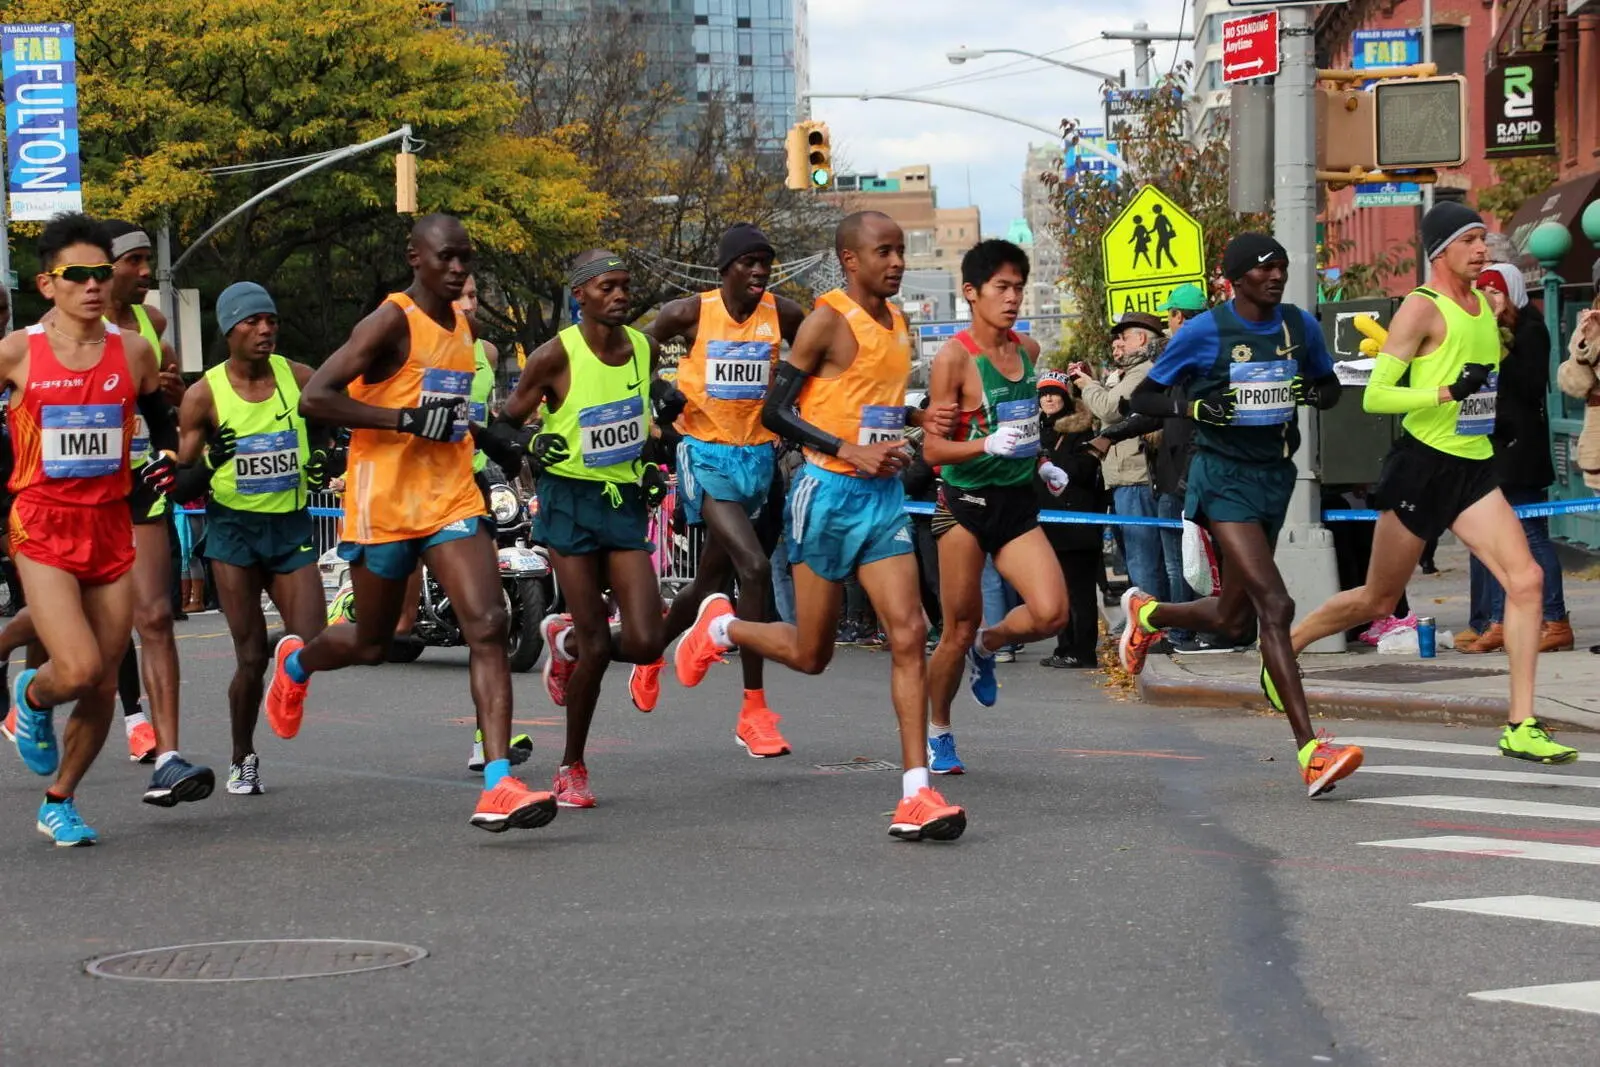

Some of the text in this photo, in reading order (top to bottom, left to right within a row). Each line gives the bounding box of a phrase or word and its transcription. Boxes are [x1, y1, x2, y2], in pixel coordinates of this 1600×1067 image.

[1225, 19, 1269, 39] NO STANDING
[13, 36, 61, 61] FAB
[1226, 38, 1253, 53] Anytime
[1364, 40, 1406, 63] FAB
[15, 64, 68, 190] FULTON
[1496, 121, 1542, 137] RAPID
[715, 363, 763, 382] KIRUI
[60, 432, 107, 456] IMAI
[591, 421, 639, 449] KOGO
[236, 452, 299, 476] DESISA
